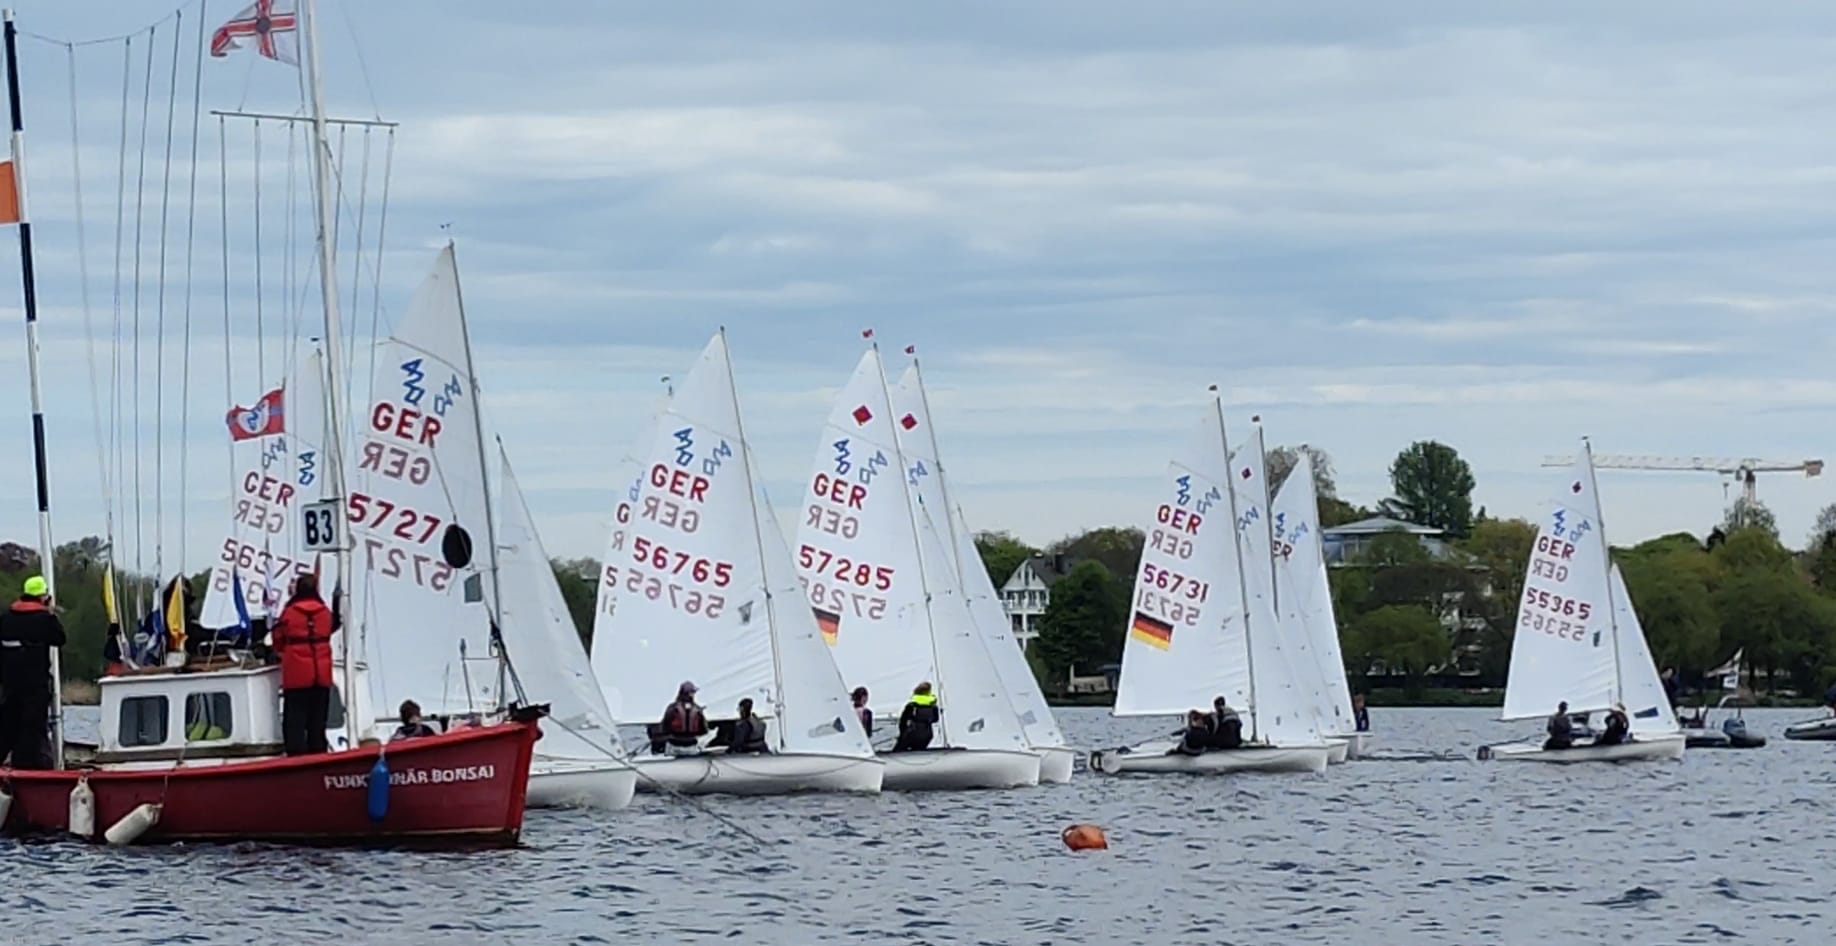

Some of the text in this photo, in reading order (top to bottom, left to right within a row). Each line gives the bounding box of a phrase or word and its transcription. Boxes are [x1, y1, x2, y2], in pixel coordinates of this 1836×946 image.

[372, 402, 441, 448] GER
[245, 471, 295, 507] GER
[651, 464, 710, 504] GER
[813, 472, 867, 511] GER
[305, 509, 334, 546] B3
[348, 492, 442, 544] 5727
[1157, 504, 1202, 536] GER
[633, 536, 733, 588] 56765
[1272, 540, 1293, 562] ER
[1538, 536, 1576, 560] GER
[800, 545, 895, 591] 57285
[1143, 563, 1209, 604] 56731
[1526, 587, 1592, 621] 55365
[324, 764, 495, 790] FUNKNÄR BONSAI
